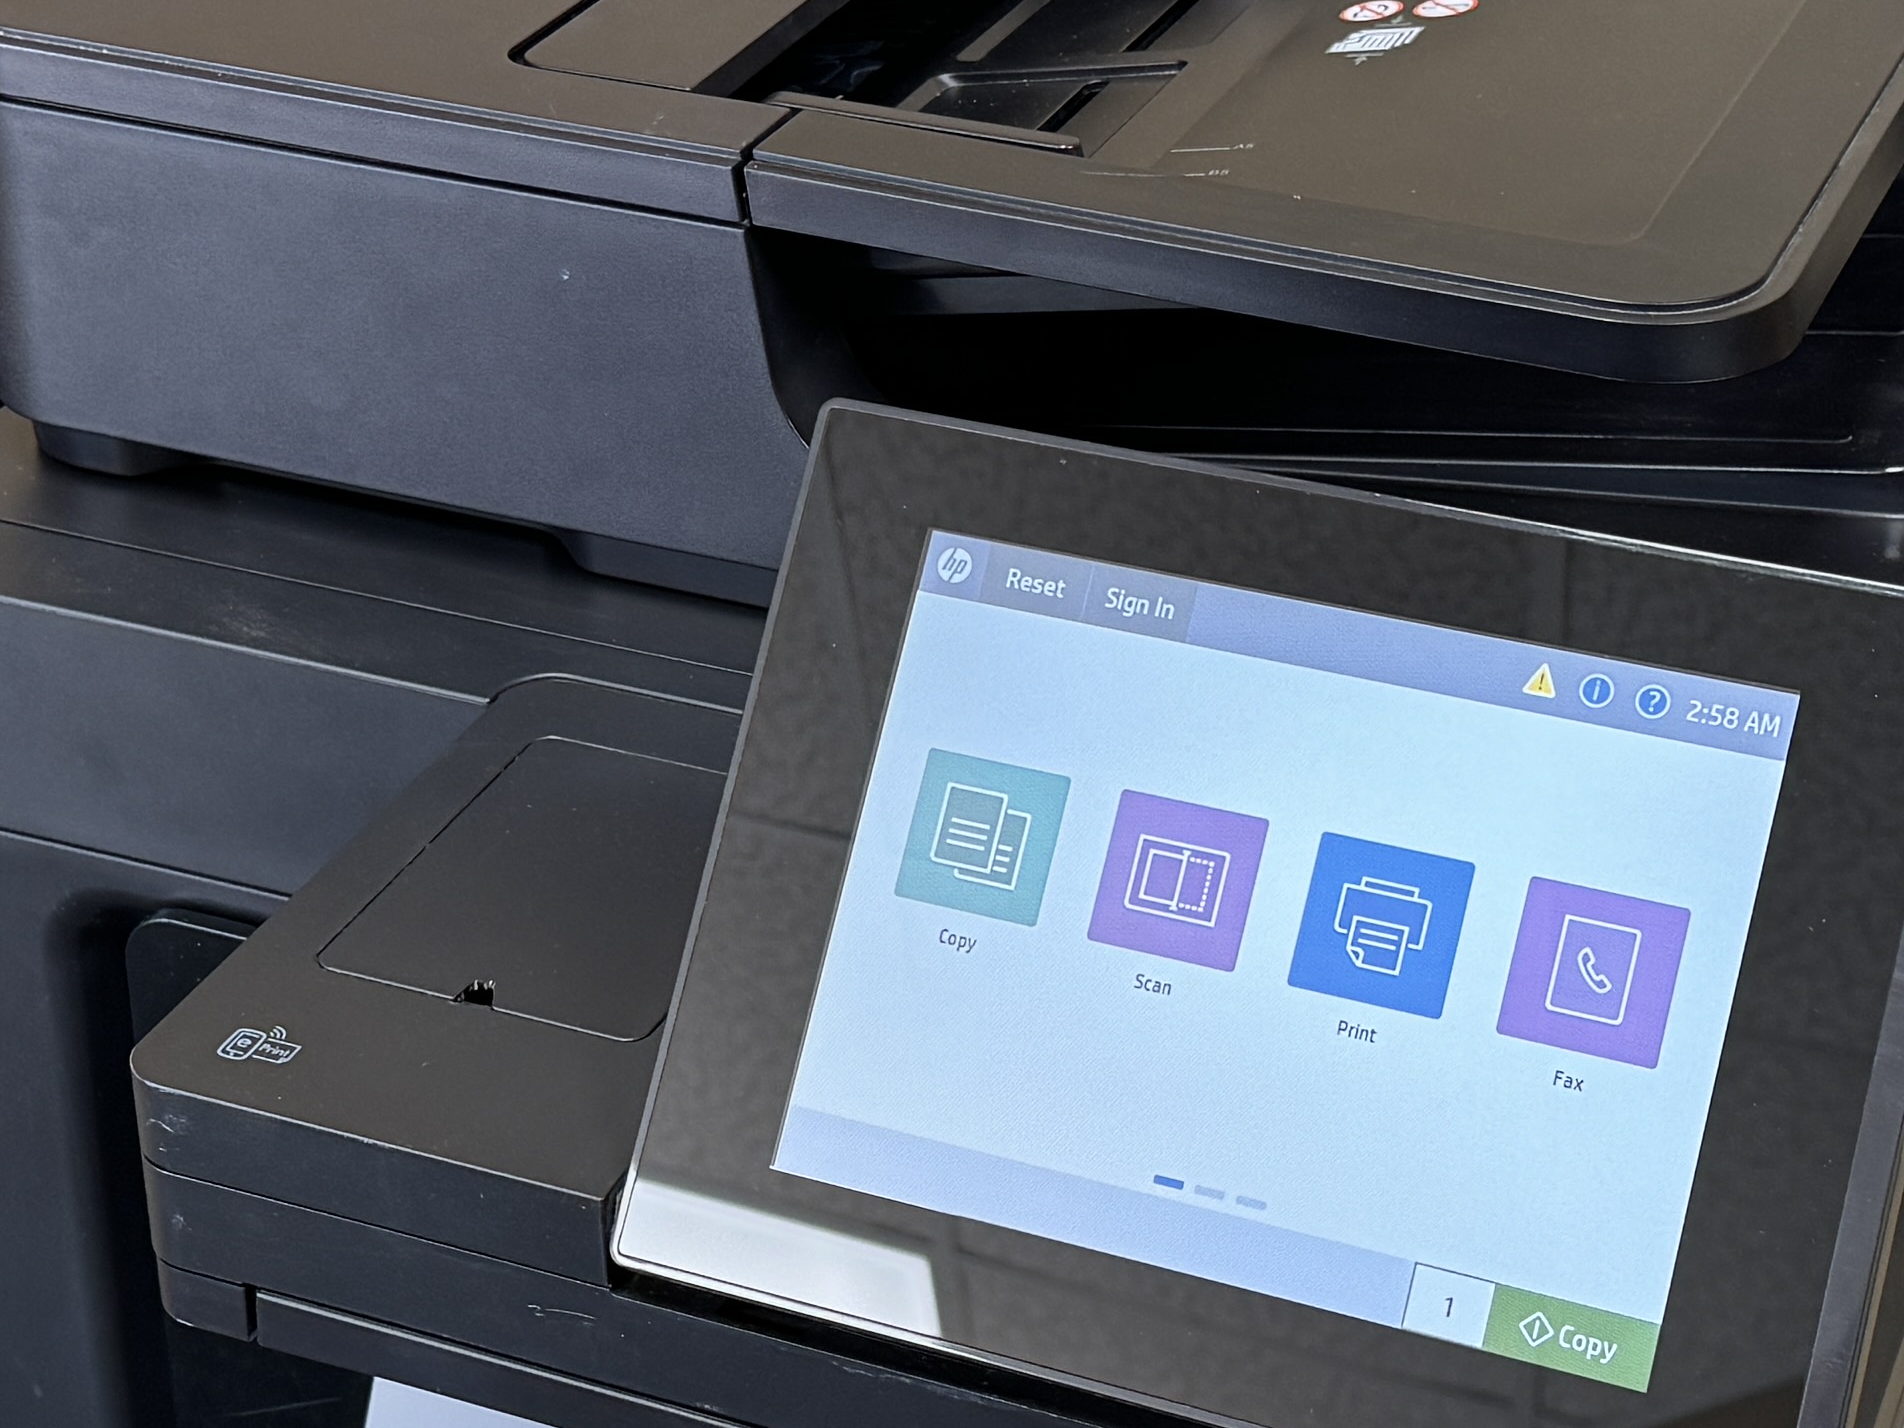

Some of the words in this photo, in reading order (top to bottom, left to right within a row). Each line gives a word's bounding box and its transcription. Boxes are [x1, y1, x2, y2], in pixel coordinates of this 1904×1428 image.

[939, 548, 970, 582] hp
[1006, 568, 1066, 598] Reset
[1105, 587, 1149, 617] Sign
[1154, 597, 1175, 620] In
[1686, 699, 1739, 729] 2:58
[1744, 711, 1781, 737] AM
[939, 929, 977, 953] Copy
[1134, 974, 1172, 995] Scan
[1337, 1020, 1377, 1043] Print
[1553, 1070, 1584, 1092] Fax
[1445, 1297, 1454, 1317] 1
[1559, 1325, 1617, 1364] Copy
